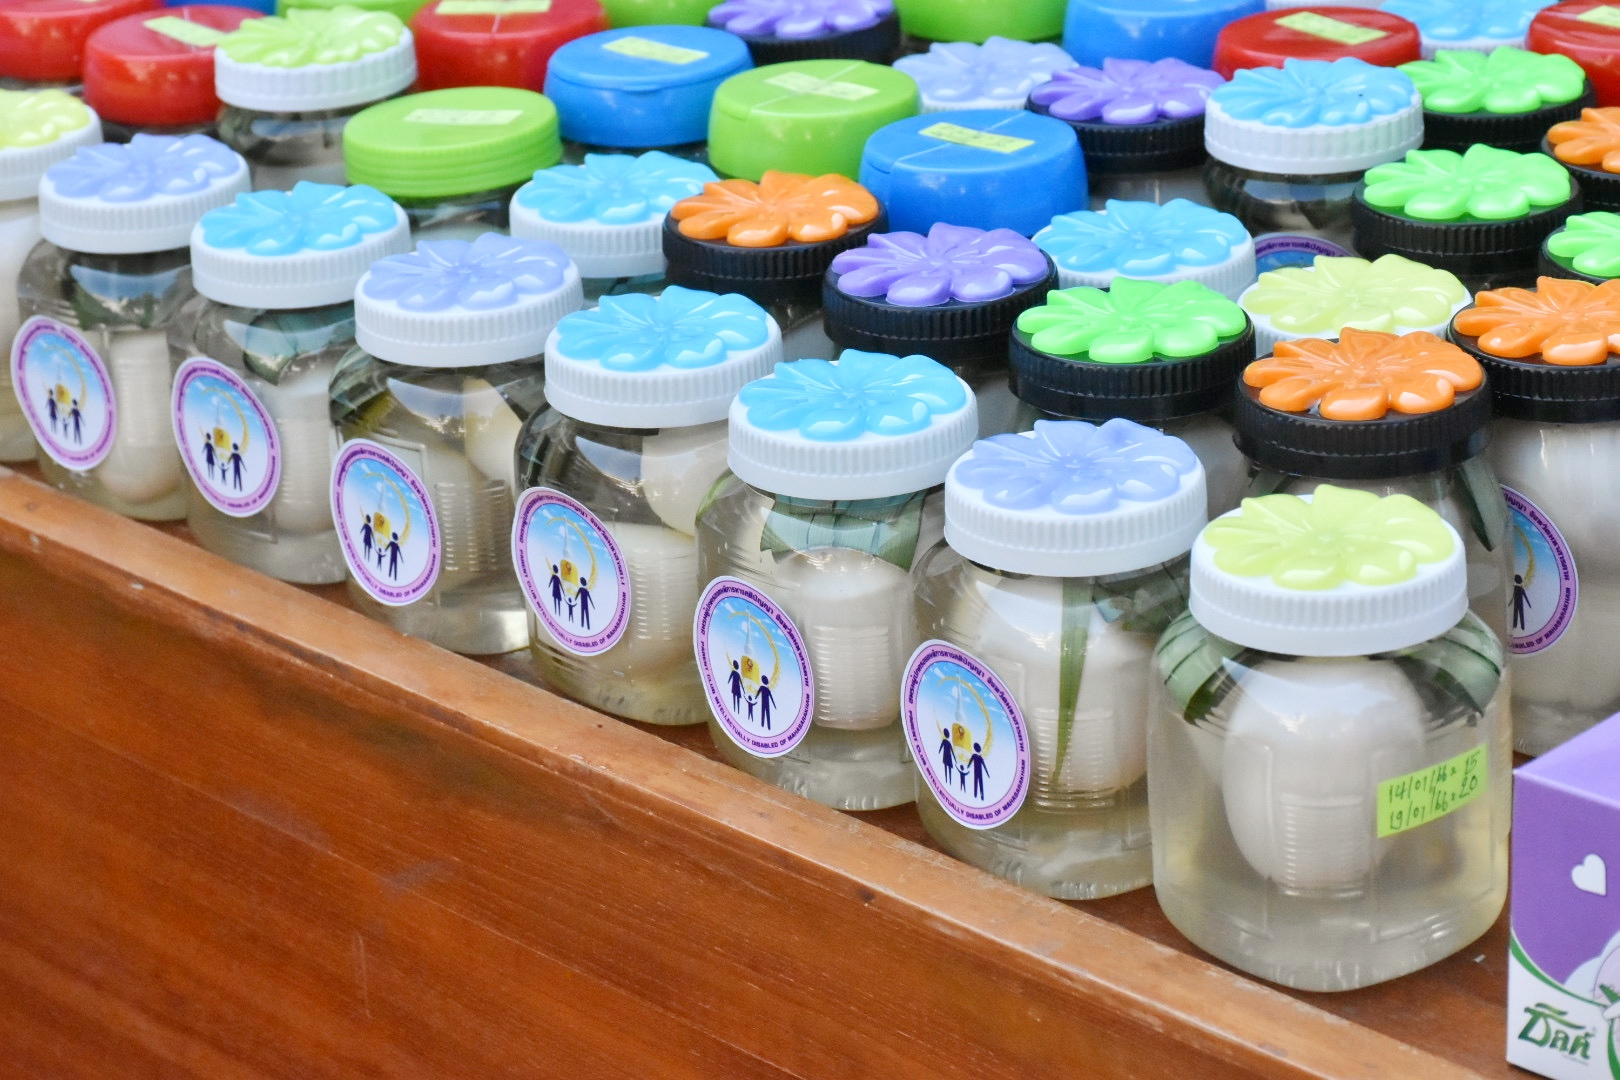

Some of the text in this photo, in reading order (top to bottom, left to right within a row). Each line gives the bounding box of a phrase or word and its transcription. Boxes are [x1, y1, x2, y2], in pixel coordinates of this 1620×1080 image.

[751, 739, 779, 749] DISABLED
[779, 737, 787, 746] OF
[965, 810, 994, 821] DISABLED
[994, 808, 1002, 817] OF
